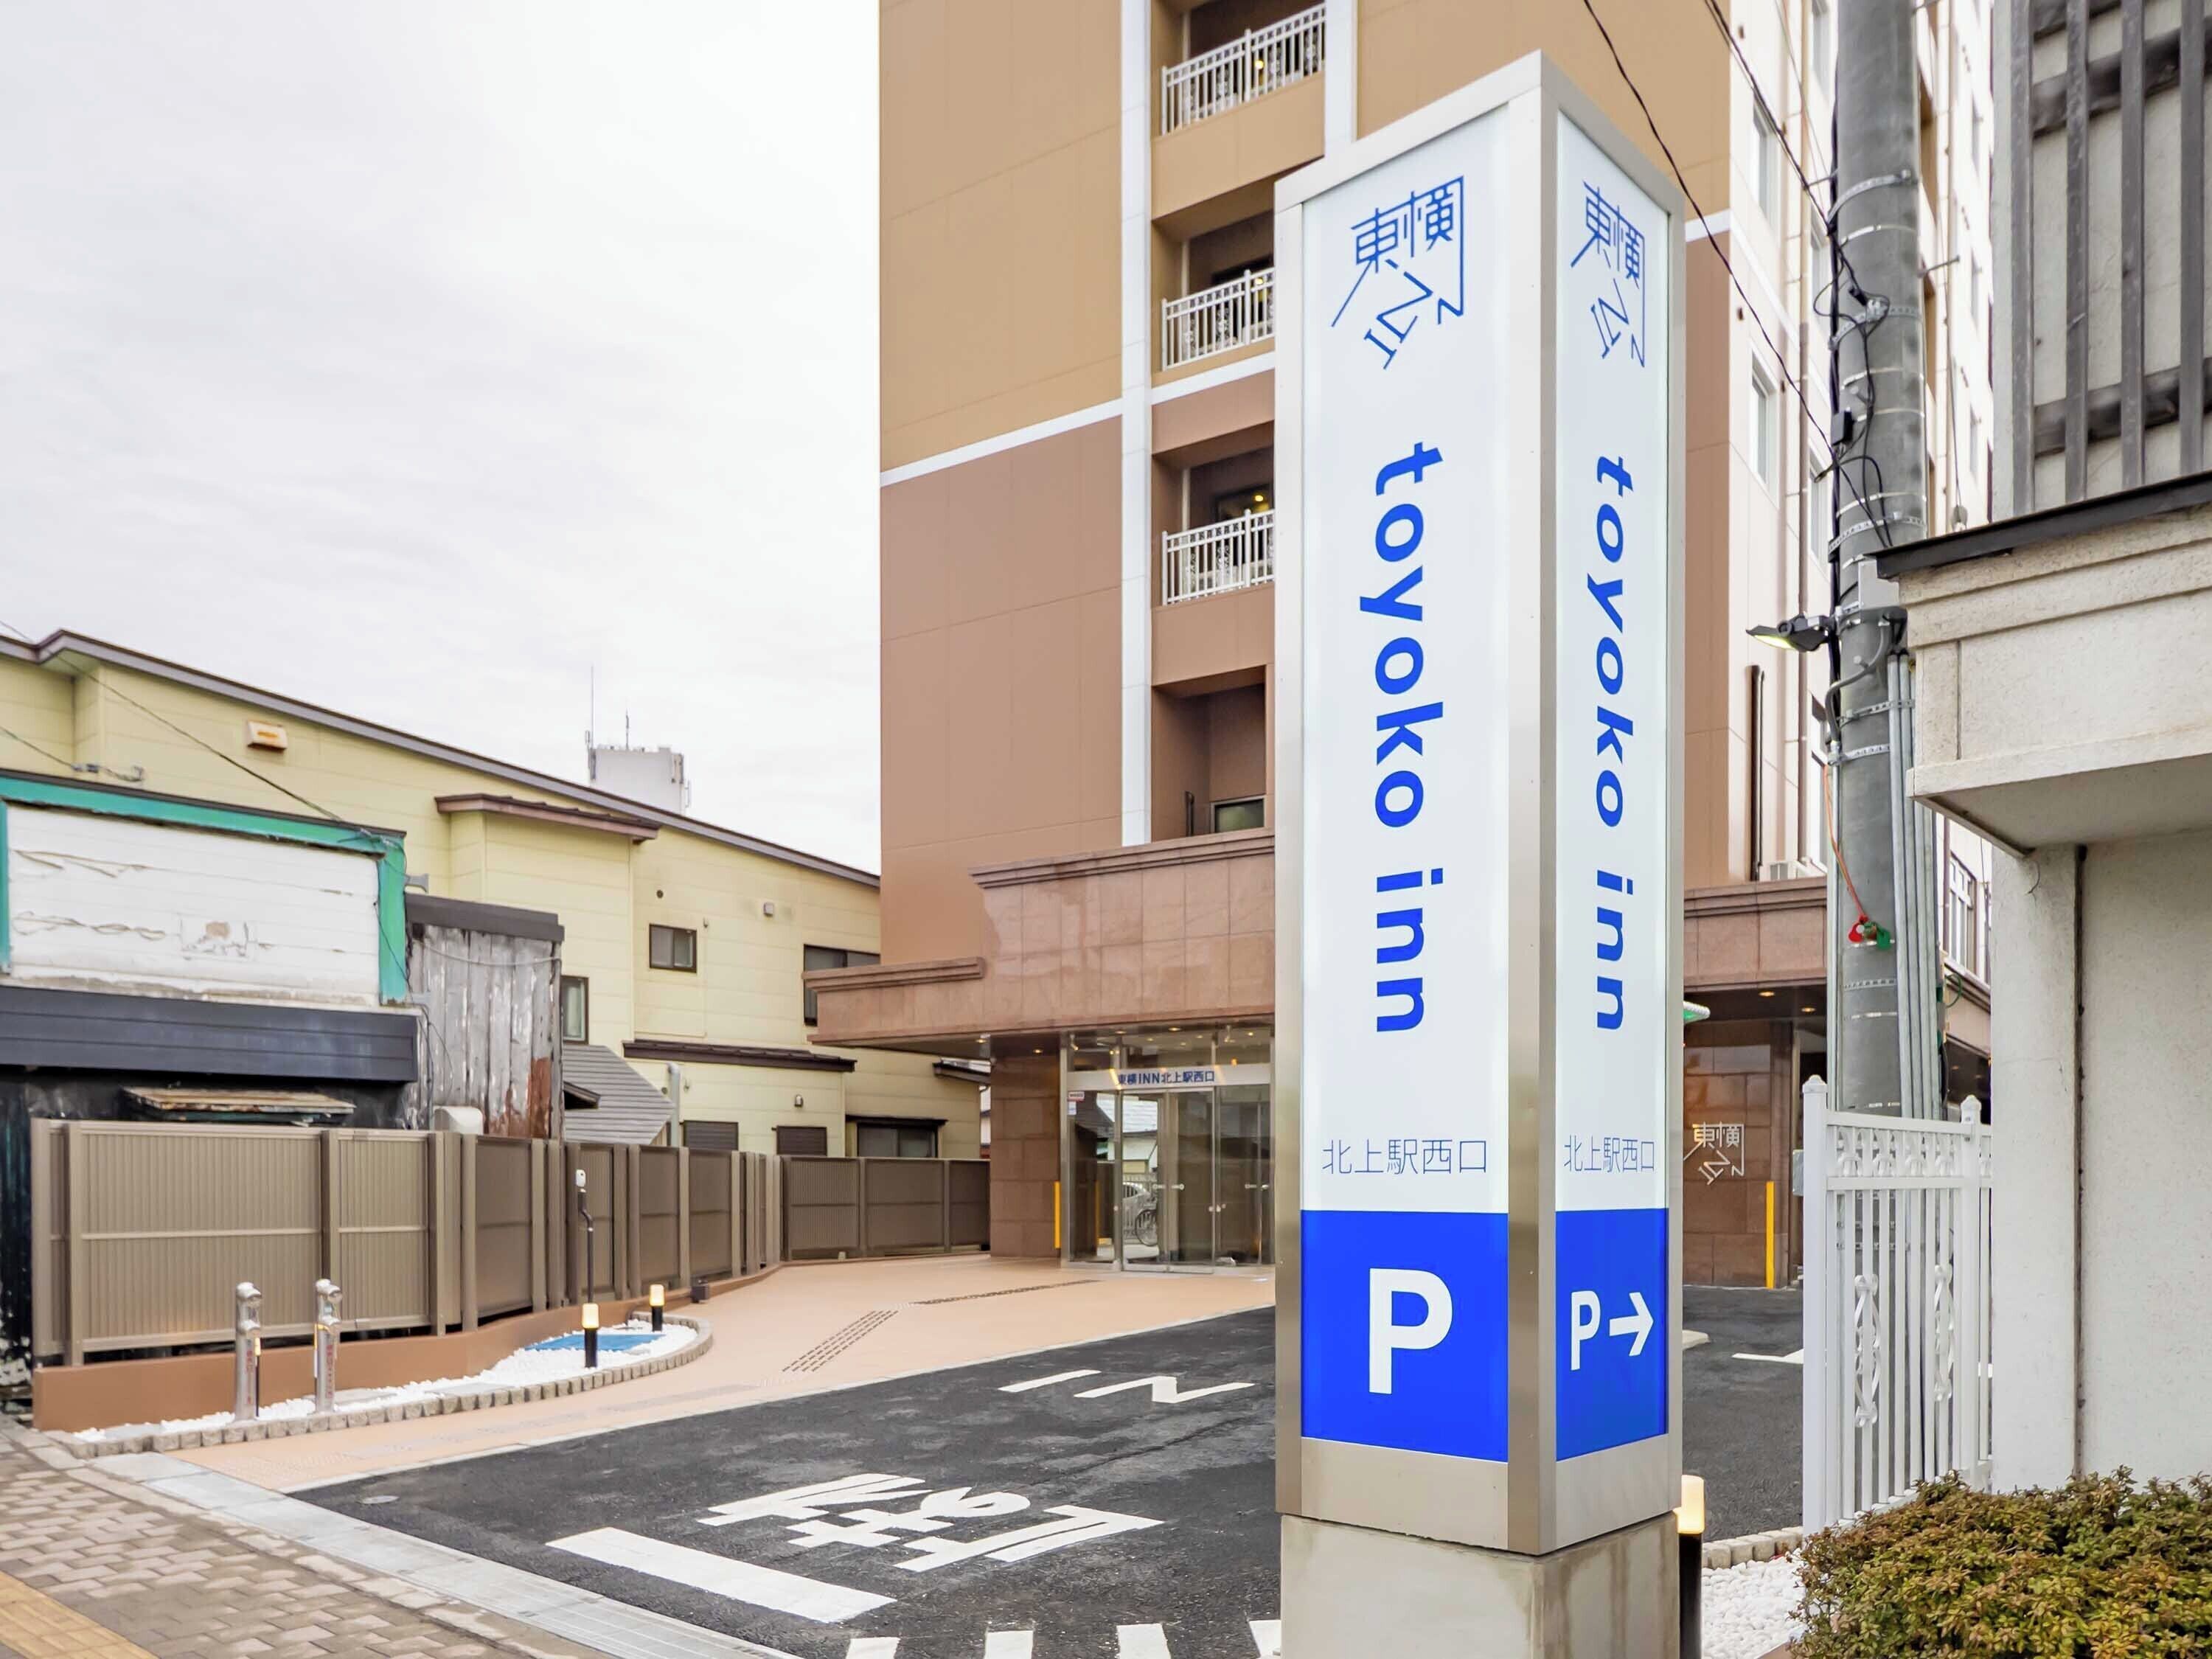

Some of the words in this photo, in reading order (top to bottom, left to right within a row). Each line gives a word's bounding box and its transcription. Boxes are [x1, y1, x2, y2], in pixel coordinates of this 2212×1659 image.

[1571, 180, 1644, 289] 東横
[1360, 442, 1443, 828] toyoko
[1587, 456, 1634, 828] toyoko
[1376, 867, 1443, 1032] inn
[1596, 870, 1634, 1031] inn
[1322, 1138, 1487, 1175] 北上駅西口
[1564, 1134, 1655, 1174] 北上駅西口
[1369, 1267, 1453, 1394] P
[1571, 1290, 1601, 1371] P
[696, 1473, 1165, 1573] 止まれ
